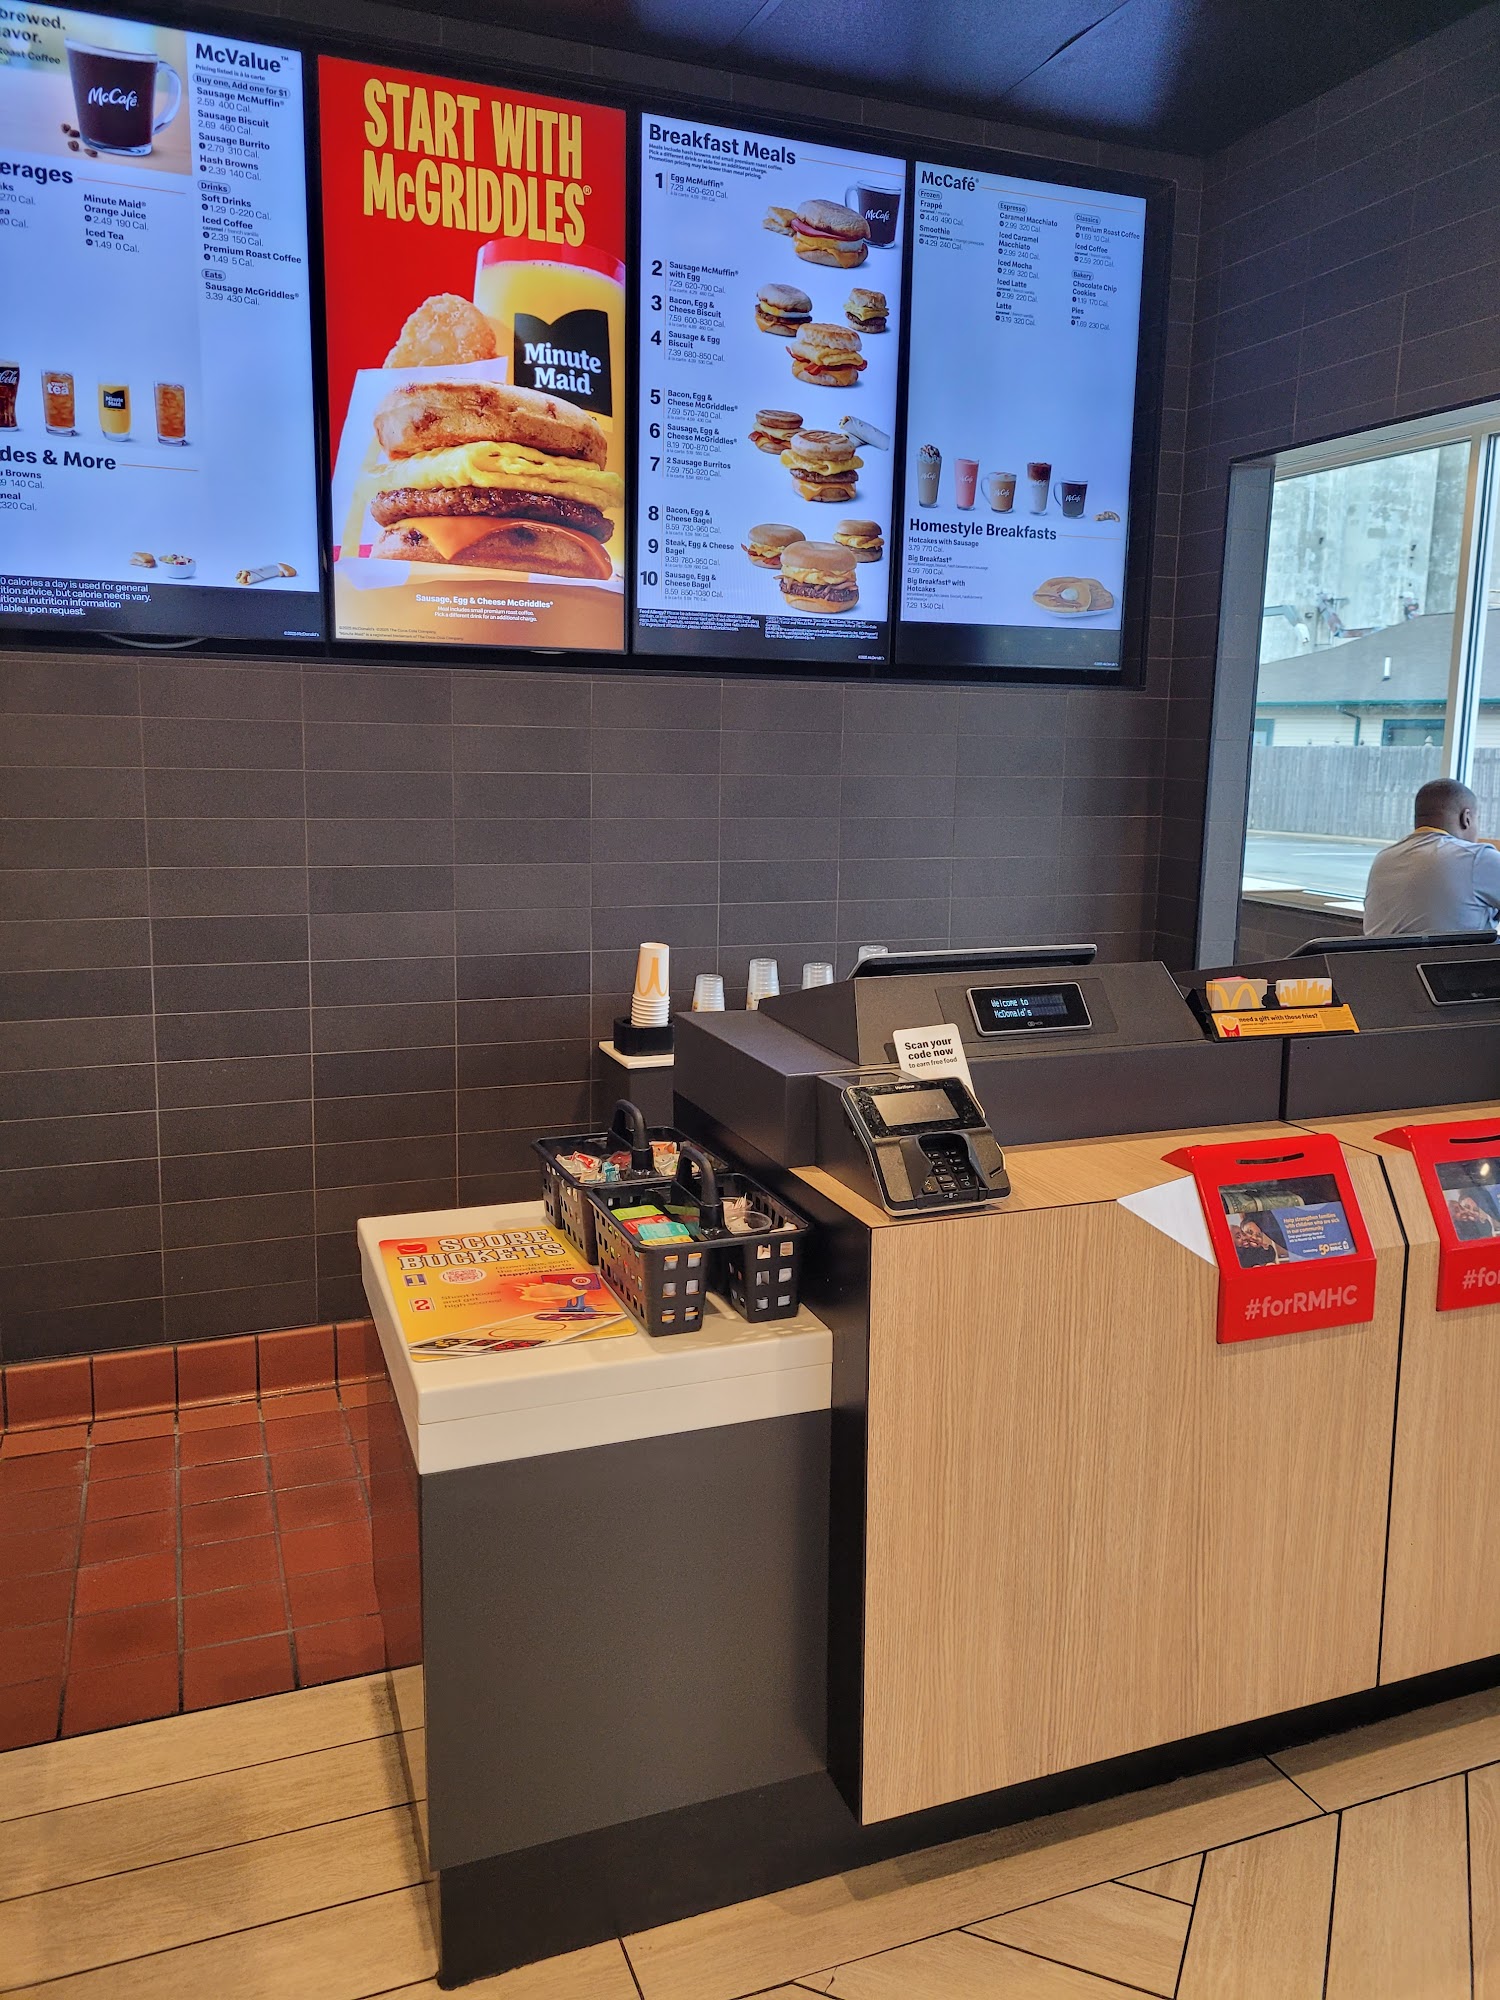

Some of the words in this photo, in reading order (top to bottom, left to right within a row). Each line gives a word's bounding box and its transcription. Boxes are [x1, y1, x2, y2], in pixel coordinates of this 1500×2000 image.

[0, 7, 66, 30] brewed.
[197, 76, 211, 86] Buy
[214, 78, 231, 88] one,
[232, 82, 248, 90] Add
[250, 84, 265, 93] one
[266, 85, 277, 95] for
[279, 89, 288, 97] $1
[88, 86, 138, 111] McCafé
[197, 87, 235, 101] Sausage
[197, 97, 215, 106] 2.59
[219, 100, 235, 109] 400
[236, 103, 252, 113] Cal.
[198, 110, 236, 124] Sausage
[238, 116, 270, 128] Biscuit
[364, 78, 481, 162] START
[491, 100, 582, 180] WITH
[199, 132, 238, 146] Sausage
[240, 138, 270, 151] Burrito
[650, 123, 739, 156] Breakfast
[744, 140, 796, 165] Meals
[200, 154, 223, 165] Hash
[225, 158, 259, 170] Browns
[0, 162, 73, 185] erages
[671, 173, 685, 184] Egg
[655, 172, 663, 189] 1
[201, 182, 228, 193] Drinks
[84, 194, 117, 206] Minute
[201, 194, 220, 203] Soft
[222, 196, 252, 208] Drinks
[920, 190, 940, 199] Frozen
[920, 200, 943, 210] Frappé
[1000, 203, 1026, 213] Espresso
[84, 205, 119, 217] Orange
[121, 209, 147, 220] Juice
[202, 216, 222, 225] Iced
[224, 218, 253, 230] Coffee
[1000, 212, 1026, 222] Caramel
[1026, 216, 1058, 227] Macchiato
[1076, 215, 1099, 224] Classics
[86, 228, 106, 238] Iced
[108, 231, 124, 240] Tea
[919, 224, 950, 235] Smoothie
[1076, 224, 1102, 234] Premium
[1104, 228, 1121, 237] Roast
[1121, 230, 1140, 240] Coffee
[999, 232, 1012, 240] Iced
[1013, 233, 1039, 244] Caramel
[998, 240, 1031, 251] Macchiato
[204, 244, 244, 256] Premium
[246, 249, 271, 260] Roast
[273, 253, 302, 264] Coffee
[652, 260, 663, 277] 2
[670, 261, 700, 273] Sausage
[998, 259, 1011, 268] Iced
[1012, 261, 1033, 270] Mocha
[205, 271, 223, 279] Eats
[670, 271, 686, 279] with
[687, 273, 700, 282] Egg
[1074, 272, 1092, 281] Bakery
[206, 282, 244, 295] Sausage
[1072, 289, 1096, 298] Cookies
[1073, 281, 1103, 291] Chocolate
[1104, 285, 1117, 294] Chip
[206, 292, 223, 301] 3.39
[227, 294, 242, 303] 430
[244, 296, 260, 306] Cal.
[651, 295, 662, 311] 3
[669, 296, 694, 307] Bacon,
[695, 300, 708, 309] Egg
[669, 305, 696, 315] Cheese
[697, 308, 722, 319] Biscuit
[996, 302, 1012, 311] Latte
[1072, 307, 1084, 315] Pies
[650, 330, 662, 346] 4
[669, 331, 699, 342] Sausage
[707, 336, 720, 345] Egg
[669, 340, 694, 349] Biscuit
[523, 342, 602, 374] Minute
[534, 366, 595, 396] Maid
[650, 389, 661, 405] 5
[668, 390, 692, 400] Bacon,
[693, 392, 706, 402] Egg
[668, 399, 694, 408] Cheese
[650, 423, 661, 439] 6
[0, 446, 38, 464] des
[42, 449, 58, 466] &
[64, 451, 116, 470] More
[650, 456, 660, 472] 7
[672, 458, 702, 467] Sausage
[703, 460, 731, 469] Burritos
[6, 469, 42, 479] Browns
[648, 506, 659, 521] 8
[910, 518, 983, 538] Homestyle
[986, 523, 1057, 540] Breakfasts
[648, 539, 659, 554] 9
[666, 539, 688, 548] Steak,
[688, 540, 700, 549] Egg
[709, 542, 734, 550] Cheese
[908, 536, 938, 545] Hotcakes
[938, 538, 953, 546] with
[954, 539, 979, 549] Sausage
[665, 547, 685, 556] Bagel
[908, 555, 918, 563] Big
[640, 570, 658, 586] 10
[8, 578, 43, 588] calories
[52, 580, 68, 590] day
[70, 580, 77, 589] is
[79, 581, 100, 590] used
[102, 582, 114, 591] for
[116, 584, 149, 593] general
[416, 594, 452, 605] Sausage,
[453, 596, 468, 607] Egg
[470, 597, 476, 605] &
[477, 597, 506, 607] Cheese
[991, 1000, 1019, 1008] Welcome
[1020, 998, 1029, 1006] to
[994, 1008, 1032, 1019] McDonald's
[1259, 1015, 1270, 1023] gift
[905, 1041, 929, 1050] Scan
[930, 1038, 952, 1049] your
[908, 1050, 932, 1060] code
[934, 1048, 953, 1057] now
[438, 1228, 554, 1253] SCORE
[398, 1243, 566, 1271] BUCKETS
[406, 1274, 426, 1287] 1
[415, 1299, 431, 1312] 2
[1244, 1284, 1359, 1322] #forRMHC
